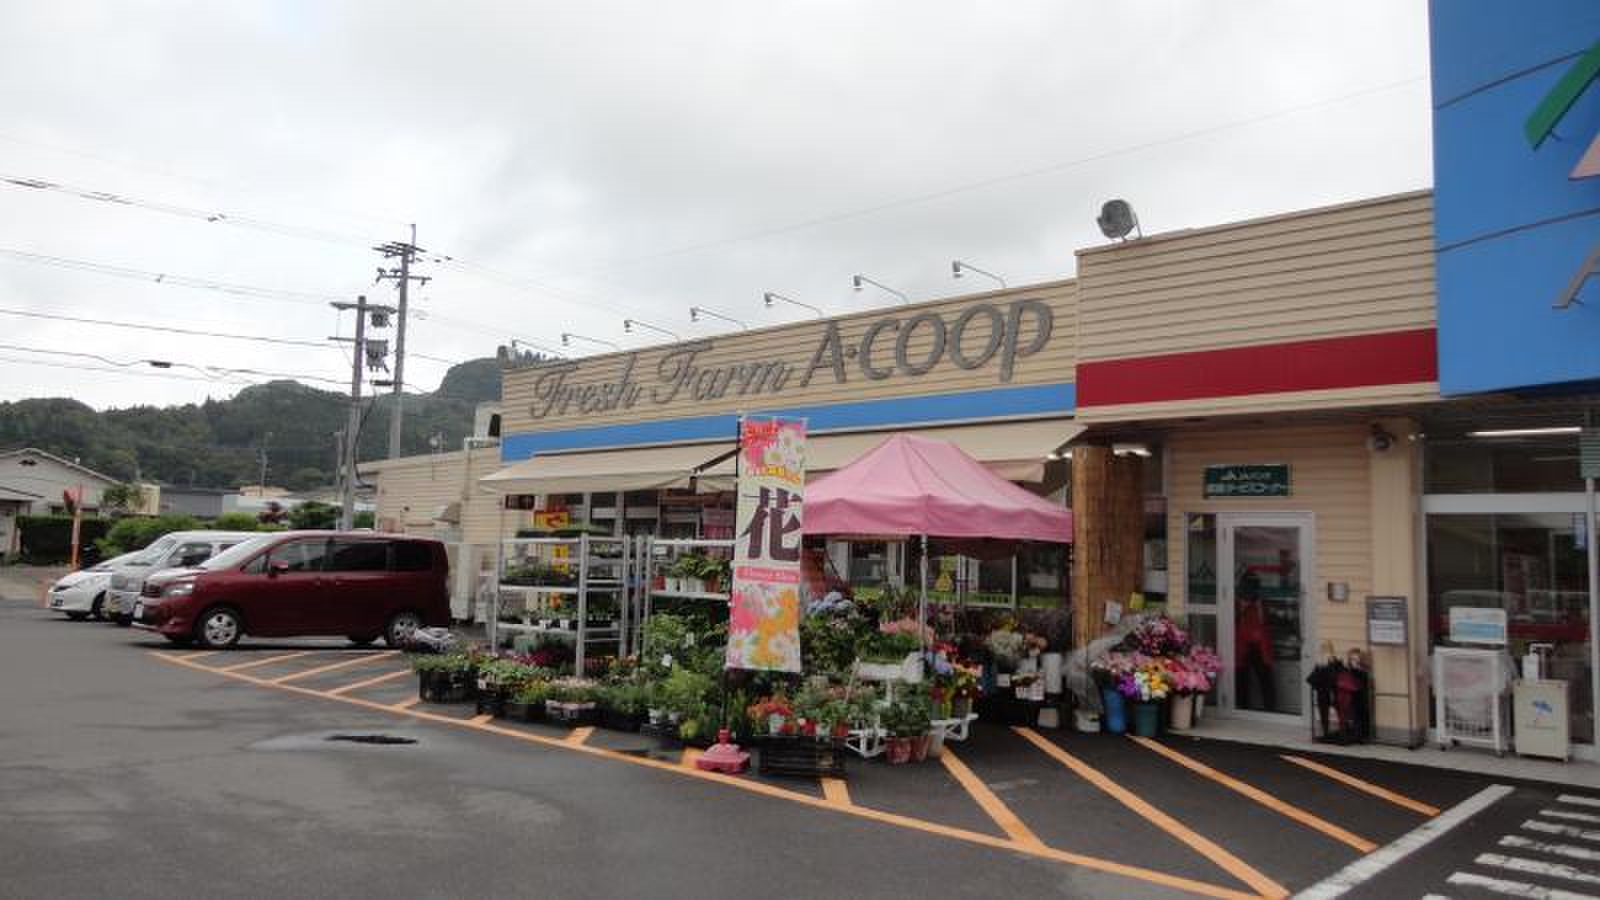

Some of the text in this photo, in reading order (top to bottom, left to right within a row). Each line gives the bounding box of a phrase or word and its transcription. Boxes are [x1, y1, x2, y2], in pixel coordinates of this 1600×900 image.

[530, 353, 643, 418] Fresh
[653, 339, 795, 404] Farm
[738, 486, 802, 561] 花
